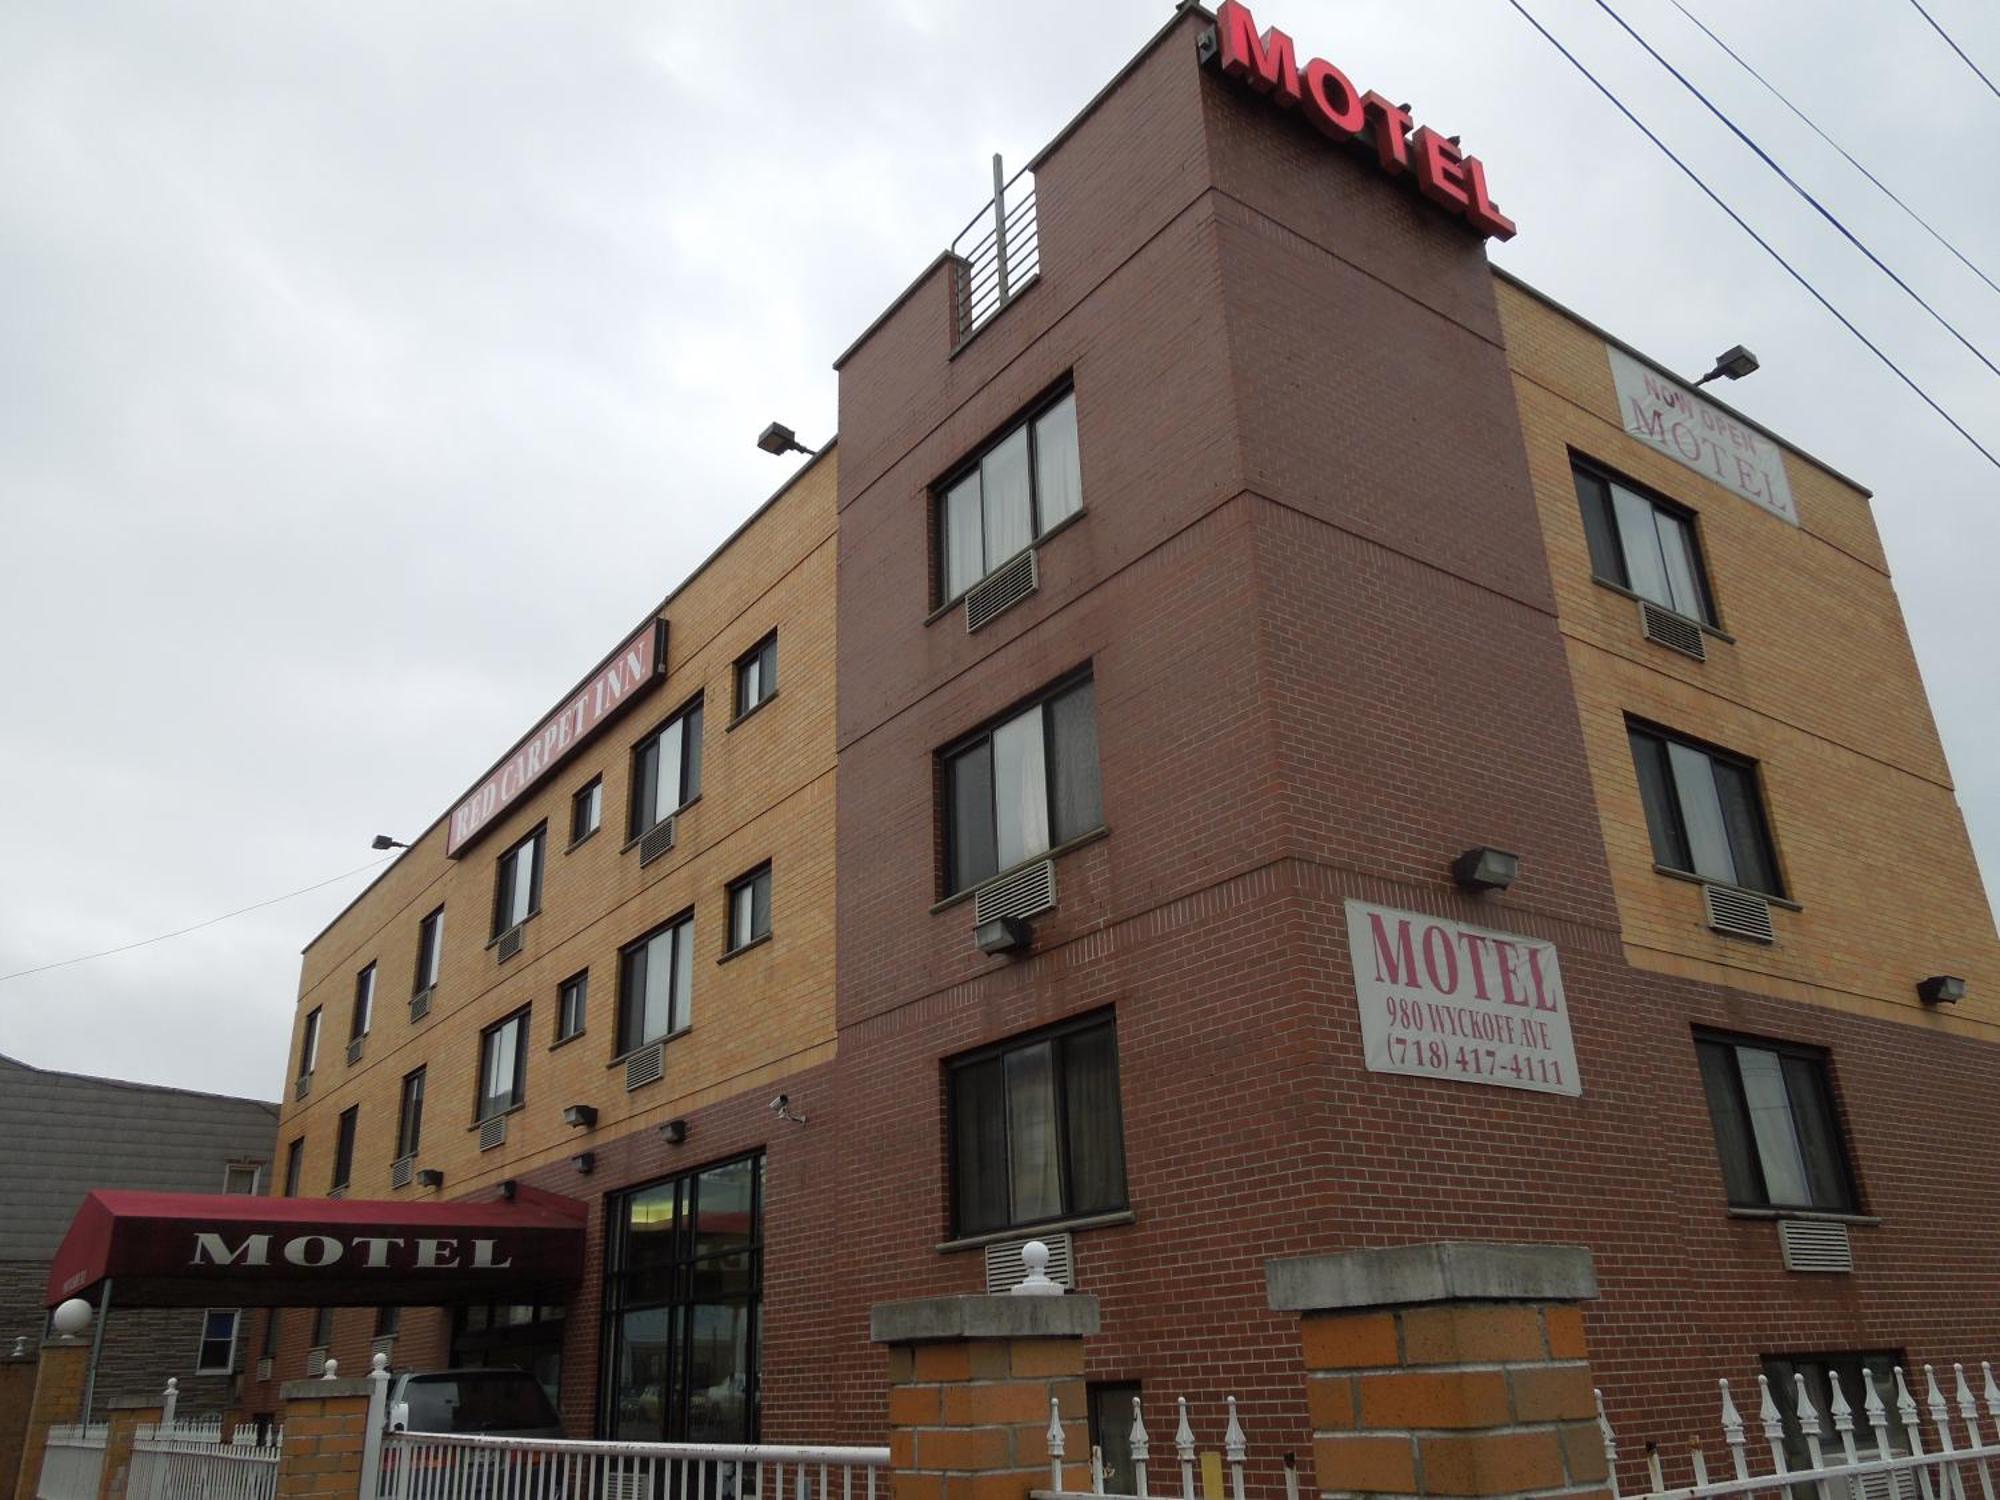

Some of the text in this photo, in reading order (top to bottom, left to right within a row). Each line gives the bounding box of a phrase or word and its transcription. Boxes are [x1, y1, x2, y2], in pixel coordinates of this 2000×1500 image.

[1217, 0, 1517, 242] MOTEL
[1644, 372, 1694, 419] NOW
[1629, 396, 1787, 513] MOTEL
[456, 641, 646, 842] RED CARPET INN
[1367, 912, 1558, 1013] MOTEL
[1386, 996, 1552, 1050] 980 WYCKOFF AVE
[1387, 1032, 1564, 1086] (718) 417-4111
[189, 1232, 512, 1269] MOTEL
